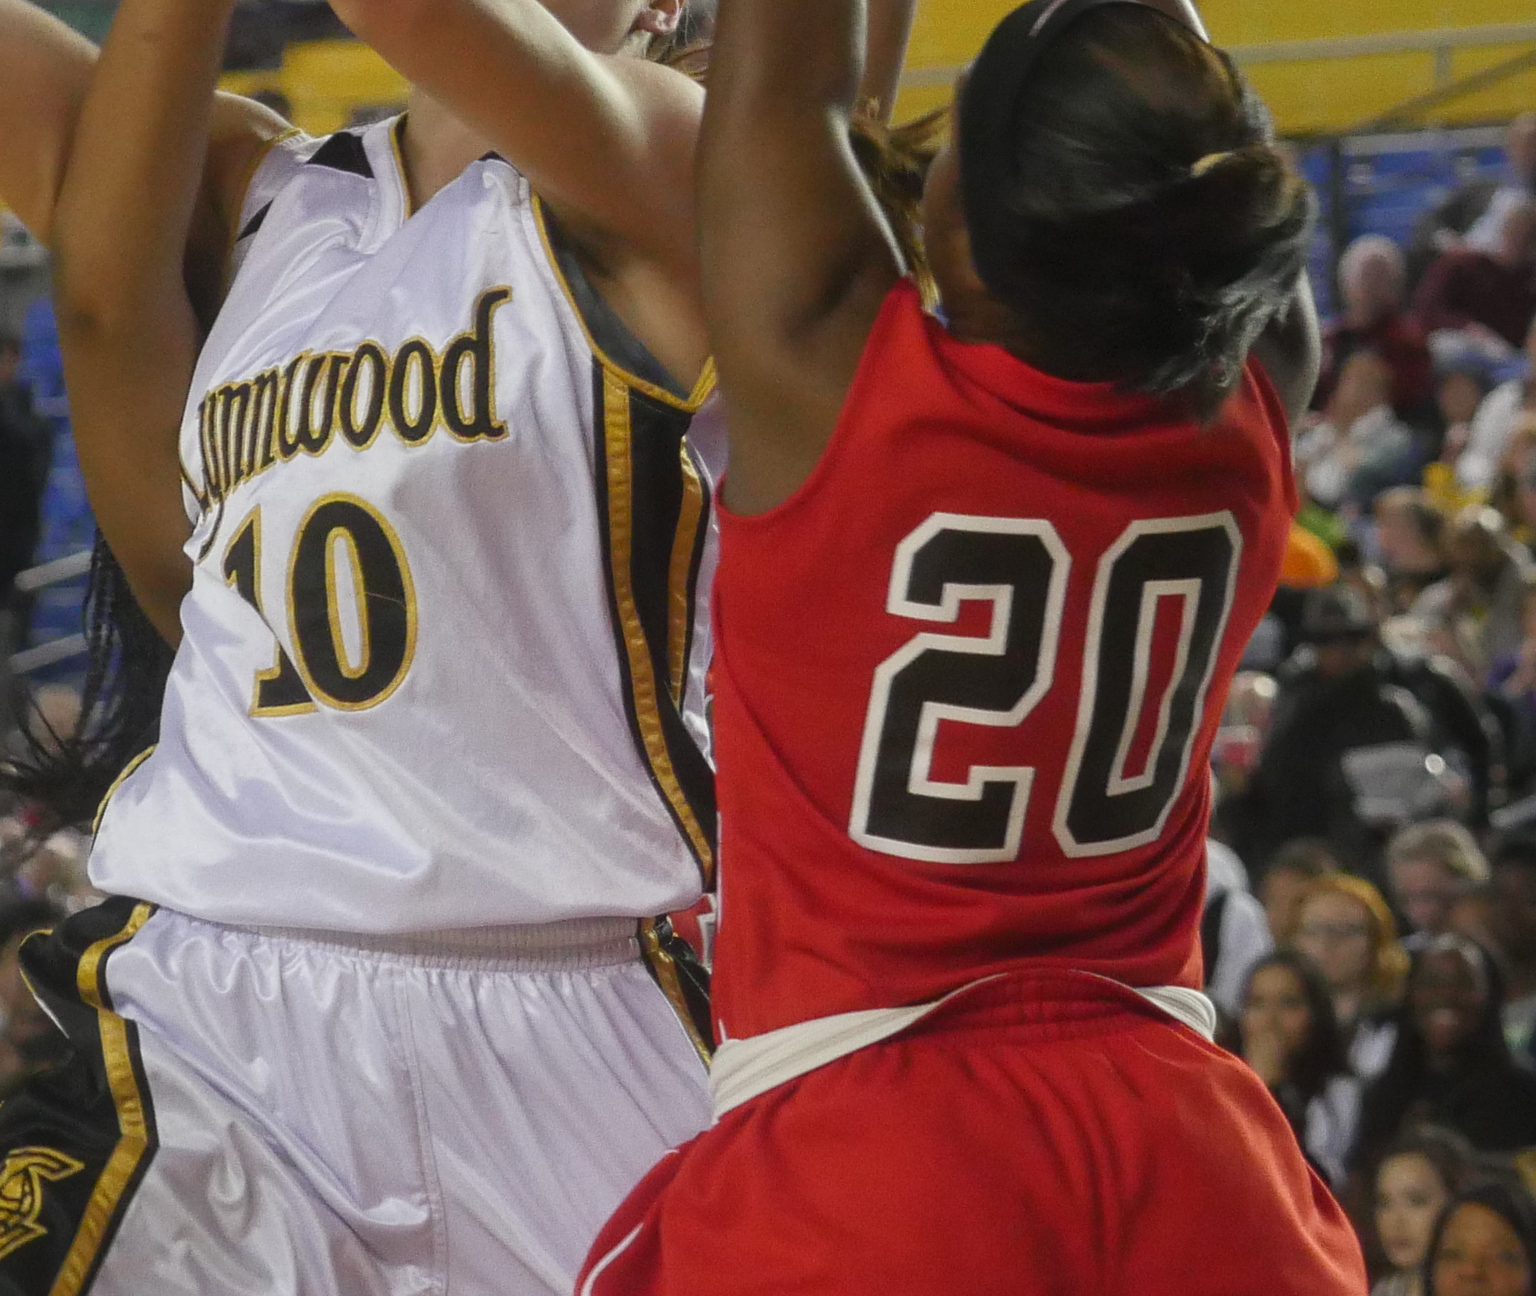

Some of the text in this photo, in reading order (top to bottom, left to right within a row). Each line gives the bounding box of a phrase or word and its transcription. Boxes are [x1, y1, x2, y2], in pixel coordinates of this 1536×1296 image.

[194, 285, 512, 564] ynnwood
[224, 491, 417, 717] 10
[848, 510, 1244, 864] 20
